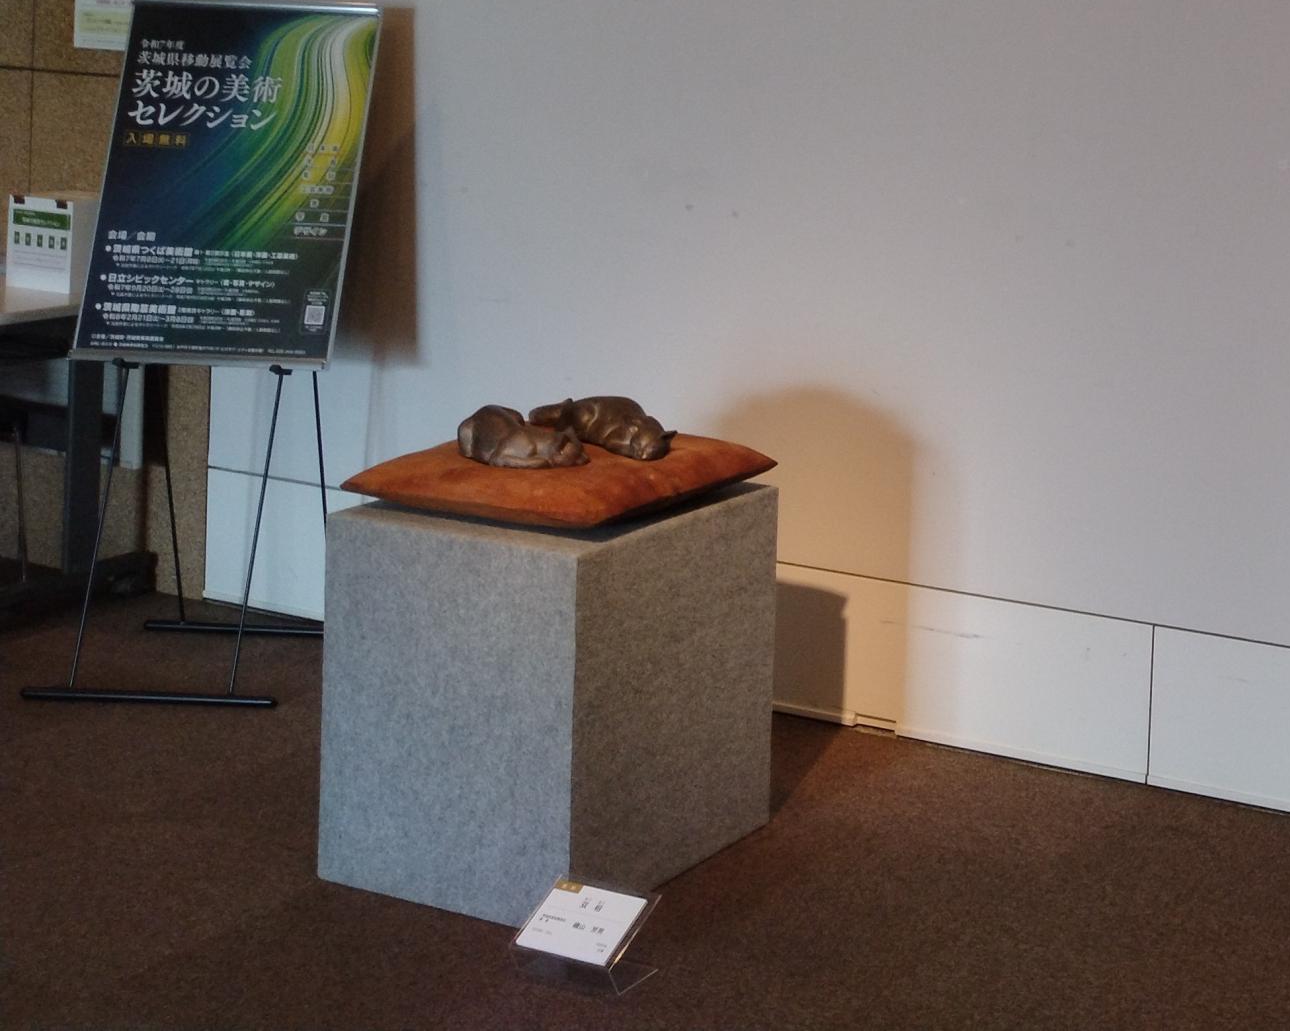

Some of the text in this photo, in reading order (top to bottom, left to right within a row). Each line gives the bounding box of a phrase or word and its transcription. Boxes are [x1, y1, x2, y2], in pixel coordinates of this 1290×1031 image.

[137, 51, 253, 69] 茨城県移動展覧会
[131, 69, 283, 104] 茨城の美術
[128, 100, 278, 131] セレクション
[108, 273, 194, 286] 日立シビックセンター
